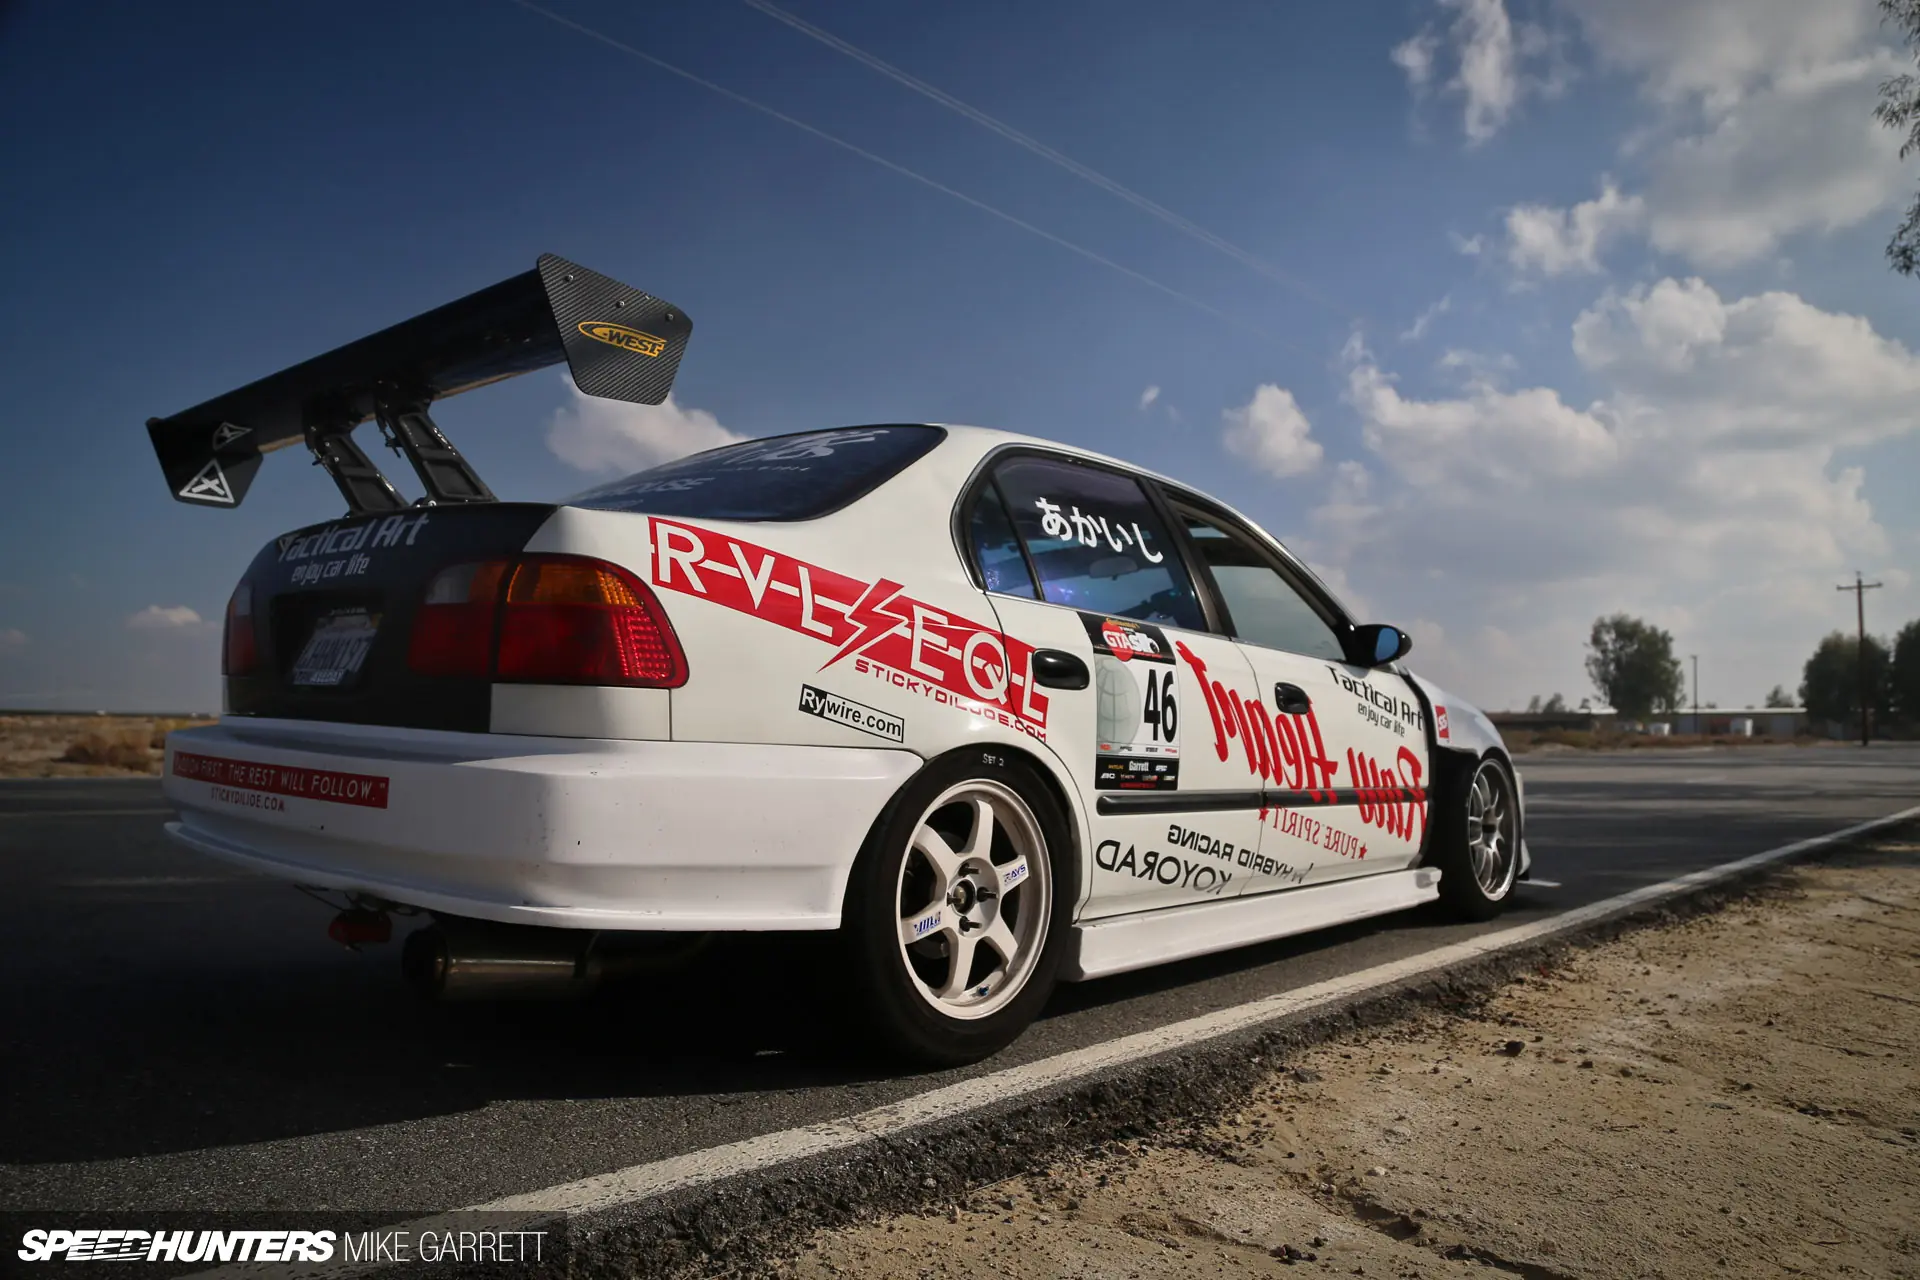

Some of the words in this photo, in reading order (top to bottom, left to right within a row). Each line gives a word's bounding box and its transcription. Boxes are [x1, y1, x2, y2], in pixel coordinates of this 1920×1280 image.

[278, 518, 378, 562] Tactical
[371, 512, 430, 548] Art
[1035, 497, 1163, 564] あかいし
[291, 560, 323, 586] enjoy
[323, 559, 347, 578] car
[345, 552, 371, 577] life
[801, 687, 901, 737] Rywire.com
[1144, 668, 1178, 743] 46
[1325, 664, 1397, 717] Tactical
[1401, 701, 1424, 731] Art
[1357, 702, 1379, 727] enjoy
[1380, 713, 1392, 730] car
[1393, 719, 1405, 738] life
[228, 763, 246, 783] THE
[249, 766, 275, 788] REST
[281, 770, 305, 792] WILL
